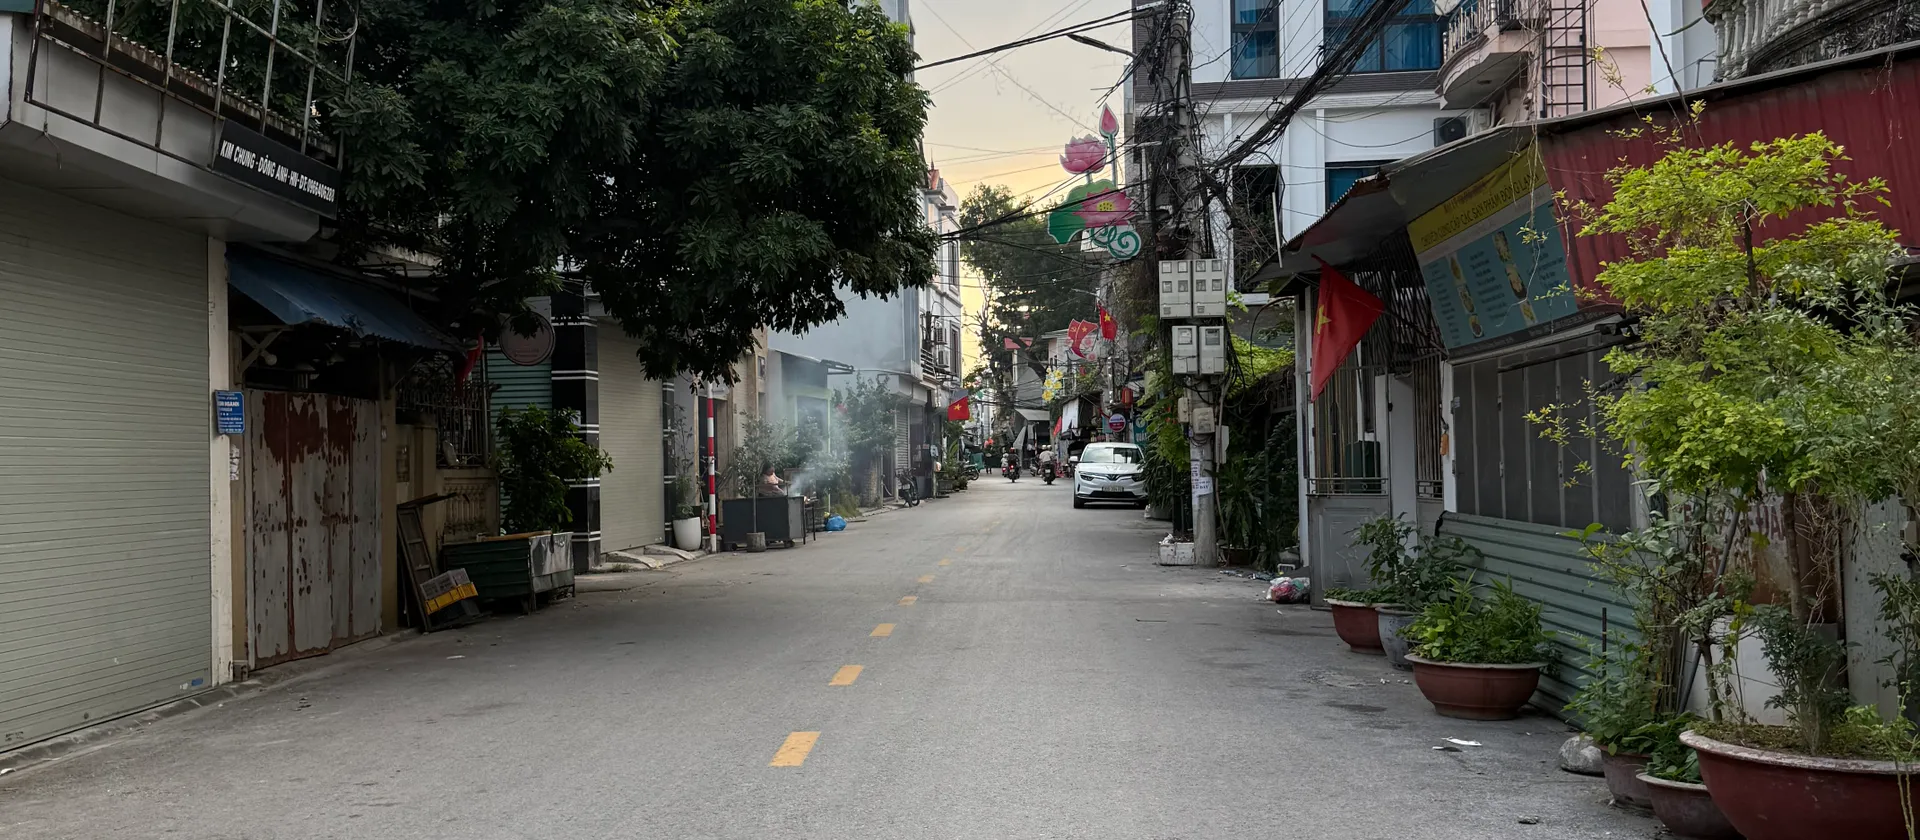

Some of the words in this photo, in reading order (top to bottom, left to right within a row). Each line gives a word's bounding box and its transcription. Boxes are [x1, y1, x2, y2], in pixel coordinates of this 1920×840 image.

[220, 140, 234, 160] KIM
[233, 146, 255, 169] CHUNG
[275, 164, 289, 183] ANH
